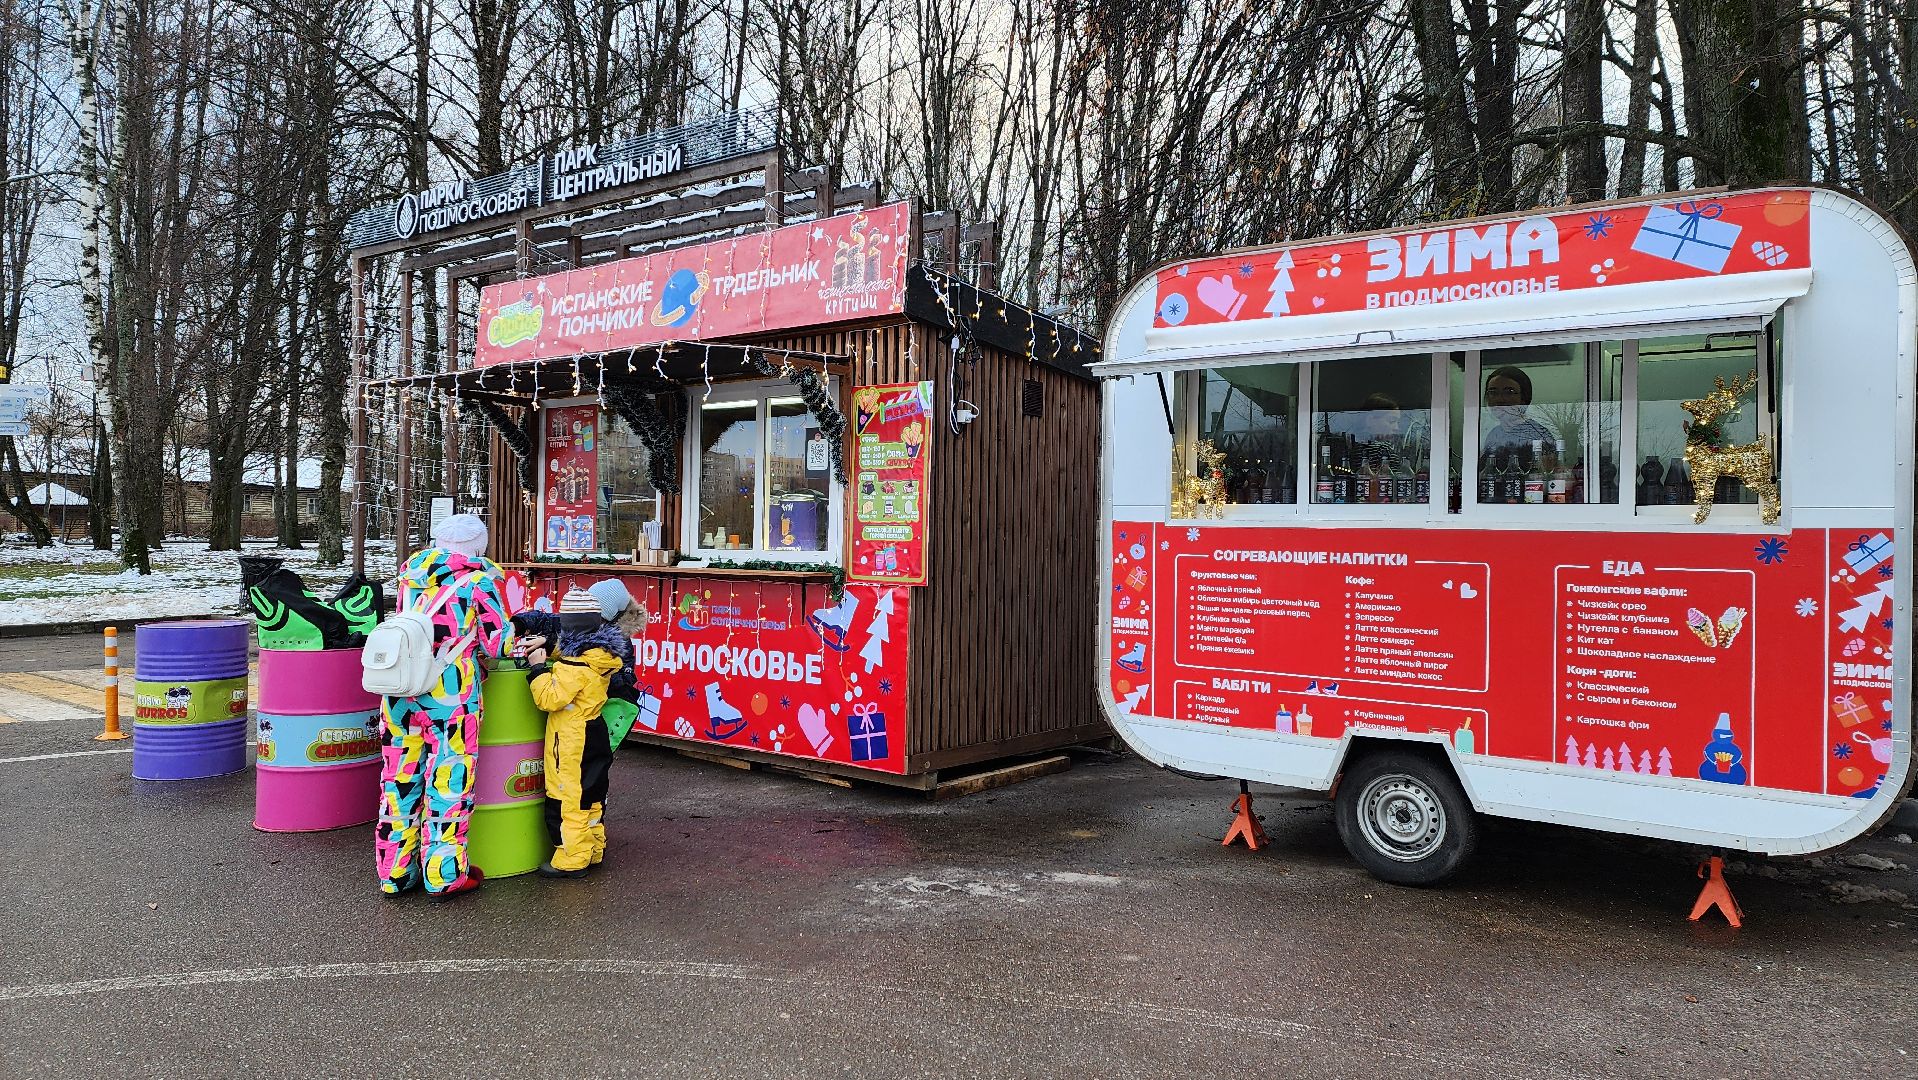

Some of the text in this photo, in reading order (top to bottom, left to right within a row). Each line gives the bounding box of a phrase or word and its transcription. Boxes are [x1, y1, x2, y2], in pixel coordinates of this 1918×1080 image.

[555, 144, 597, 174] ПАРК
[553, 145, 681, 201] ЦЕНТРАЛЬНЫЙ
[421, 180, 464, 209] ПАРКИ
[419, 189, 527, 233] ПОДМОСКОВЬЯ
[1366, 217, 1560, 283] ЗИМА
[713, 260, 820, 298] ТРДЕЛЬНИК
[551, 281, 654, 316] ИСПАНСКИЕ
[1366, 275, 1560, 310] В ПОДМОСКОВЬЕ
[558, 305, 645, 338] ПОНЧИКИ
[1214, 550, 1407, 566] СОГРЕВАЮЩИЕ НАПИТКИ
[1603, 561, 1644, 576] ЕДА
[1346, 576, 1374, 586] Кофе:
[1567, 584, 1687, 597] Гонконгские вафли:
[1355, 603, 1401, 611] Американо
[1578, 600, 1619, 609] Чизкейк
[1113, 617, 1149, 629] ЗИМА
[1197, 614, 1230, 622] Клубника
[1355, 613, 1394, 622] Эспрессо
[1578, 612, 1669, 623] Чизкейк клубника
[1355, 624, 1438, 635] Латте классический
[1578, 624, 1619, 633] Нутелла
[1633, 626, 1678, 636] бананом
[1355, 634, 1414, 646] Латте сникерс
[1578, 635, 1595, 643] Кит
[1355, 645, 1378, 653] Латте
[1578, 647, 1716, 663] Шоколадное наслаждение
[1355, 656, 1448, 670] Латте яблочный пирог
[1354, 667, 1378, 675] Латте
[1567, 665, 1596, 676] Корн
[1213, 678, 1270, 693] БАБЛ ТИ
[1578, 681, 1649, 694] Классический
[1840, 680, 1892, 688] ПОДМОСКОВ
[1587, 696, 1620, 704] сыром
[1632, 698, 1676, 708] беконом
[1354, 710, 1404, 721] Клубничный
[1578, 716, 1649, 730] Картошка фри
[321, 730, 363, 742] COSMO
[519, 761, 544, 775] COS
